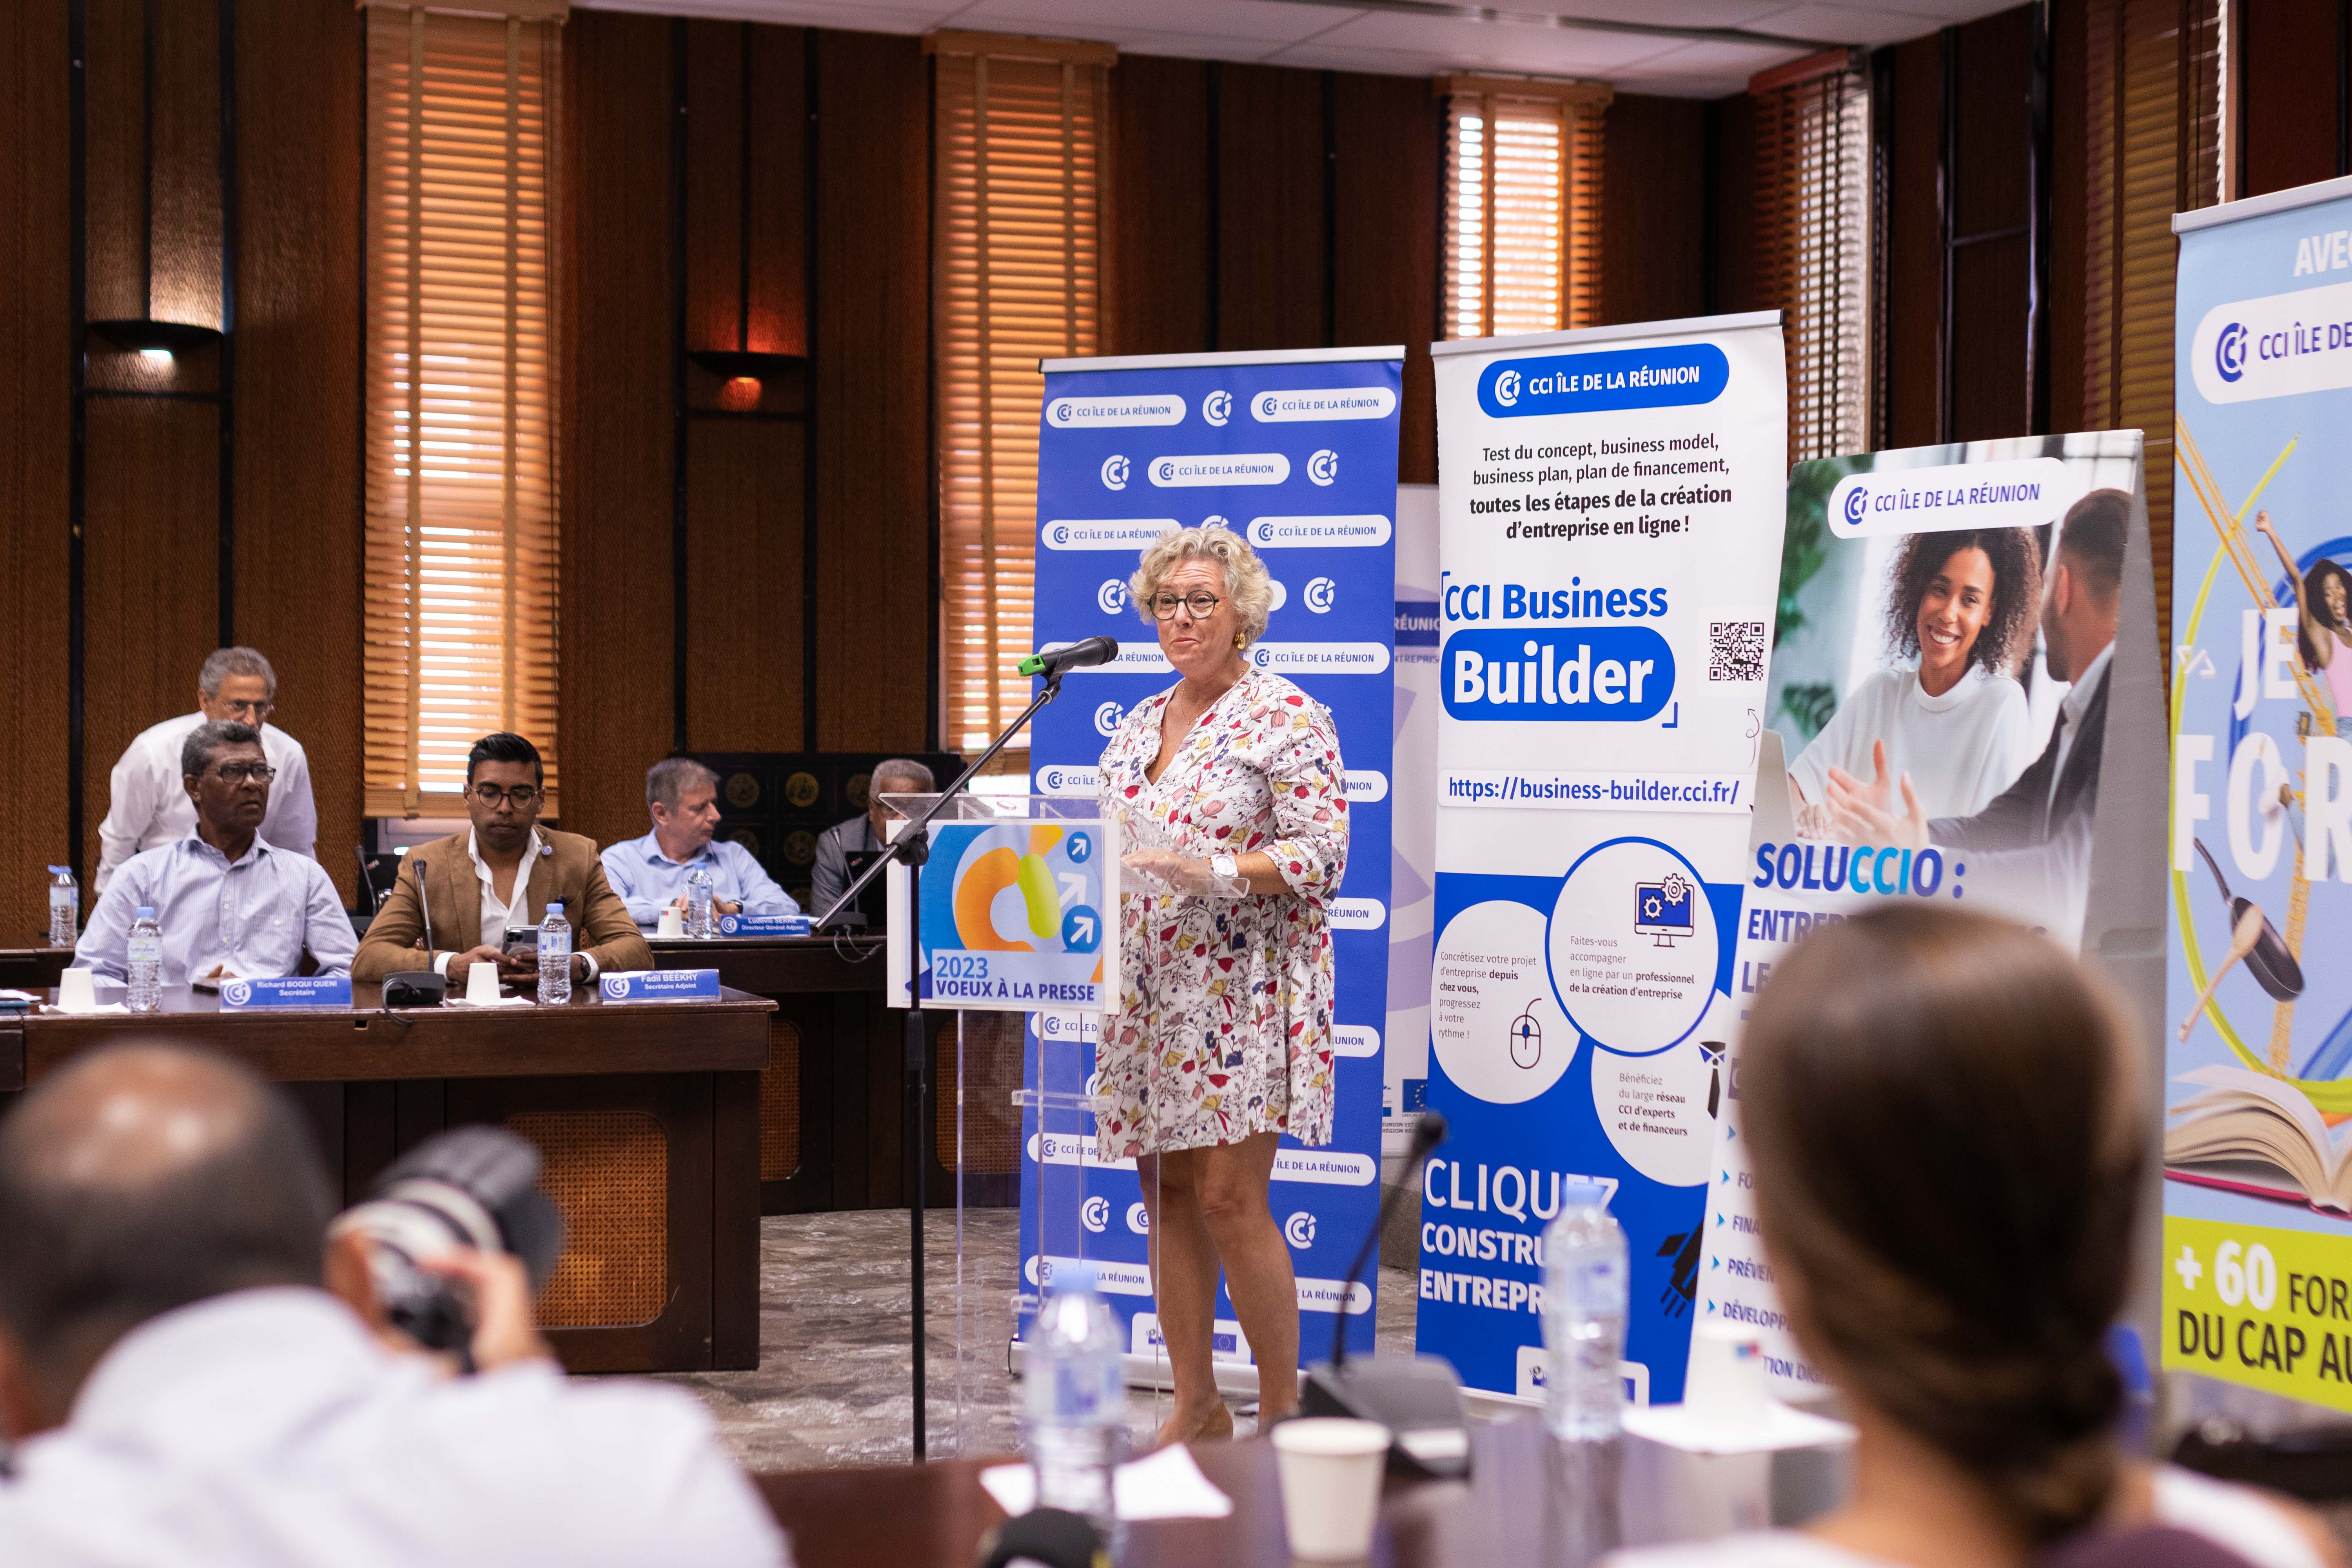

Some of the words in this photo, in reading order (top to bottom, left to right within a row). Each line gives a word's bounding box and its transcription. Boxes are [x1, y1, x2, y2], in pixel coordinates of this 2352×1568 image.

[2294, 230, 2352, 276] AVE
[2259, 332, 2288, 361] CCI
[2294, 321, 2321, 355] ÎLE
[2329, 321, 2352, 350] DE
[1529, 377, 1553, 395] CCI
[1556, 372, 1579, 393] ÎLE
[1583, 374, 1602, 391] DE
[1607, 372, 1626, 389] LA
[1630, 366, 1699, 388] RÉUNION
[1077, 408, 1090, 417] CCI
[1093, 406, 1105, 416] ÎLE
[1107, 408, 1118, 416] DE
[1120, 407, 1131, 416] LA
[1132, 405, 1171, 415] RÉUNION
[1282, 402, 1296, 410] CCI
[1298, 399, 1311, 410] ÎLE
[1314, 401, 1325, 409] DE
[1328, 400, 1338, 409] LA
[1340, 397, 1379, 408] RÉUNION
[1483, 447, 1510, 461] Test
[1514, 445, 1532, 460] du
[1537, 442, 1596, 460] concept,
[1601, 437, 1665, 455] business
[1670, 433, 1719, 451] model,
[1179, 467, 1192, 475] CCI
[1194, 465, 1207, 475] ÎLE
[1209, 466, 1220, 475] DE
[1222, 466, 1232, 474] LA
[1235, 463, 1274, 474] RÉUNION
[1474, 467, 1534, 485] business
[1538, 466, 1572, 486] plan,
[1576, 464, 1607, 483] plan
[1611, 462, 1629, 478] de
[1633, 458, 1729, 476] financement,
[1470, 497, 1521, 514] toutes
[1526, 494, 1550, 512] les
[1554, 491, 1610, 514] étapes
[1615, 490, 1636, 508] de
[1641, 489, 1656, 506] la
[1661, 483, 1731, 506] création
[1875, 494, 1896, 512] CCI
[1900, 488, 1921, 510] ÎLE
[1924, 490, 1943, 508] DE
[1947, 489, 1964, 506] LA
[1969, 483, 2040, 505] RÉUNION
[1074, 531, 1087, 539] CCI
[1089, 529, 1102, 539] ÎLE
[1104, 531, 1114, 539] DE
[1129, 528, 1162, 539] RÉUNIO
[1279, 528, 1292, 536] CCI
[1295, 525, 1308, 536] ÎLE
[1310, 528, 1321, 536] DE
[1338, 524, 1376, 535] RÉUNION
[1506, 517, 1609, 541] d’entreprise
[1613, 521, 1634, 535] en
[1639, 514, 1681, 538] ligne
[1445, 584, 1490, 621] CCI
[1503, 576, 1668, 620] Business
[1275, 654, 1289, 662] CCI
[1291, 652, 1304, 662] ÎLE
[1334, 652, 1374, 662] RÉUNION
[2232, 606, 2298, 720] JE
[1454, 640, 1654, 704] Builder
[1067, 777, 1080, 785] CCI
[1082, 775, 1095, 785] ÎLE
[1449, 776, 1739, 805] https://business-builder.cci.fr/
[1753, 842, 1943, 897] SOLUCCIO
[1328, 906, 1369, 918] RÉUNION
[1571, 935, 1618, 947] Faites-vous
[1441, 951, 1484, 963] Concrétisez
[1486, 955, 1509, 964] votre
[1512, 955, 1536, 967] projet
[1570, 953, 1626, 965] accompagner
[936, 956, 988, 979] 2023
[1440, 966, 1486, 979] d’entreprise
[1489, 969, 1518, 982] depuis
[662, 974, 698, 982] BEEKHY
[1583, 968, 1603, 980] ligne
[1606, 971, 1619, 980] par
[1636, 971, 1695, 984] professionnel
[936, 980, 993, 997] VOEUX
[997, 981, 1009, 998] À
[1014, 983, 1034, 998] LA
[1039, 984, 1094, 1001] PRESSE
[1440, 982, 1455, 992] chez
[1457, 985, 1479, 995] vous,
[1570, 983, 1580, 992] de
[1582, 984, 1590, 993] la
[1592, 985, 1628, 995] création
[1630, 986, 1682, 1000] d’entreprise
[1439, 999, 1481, 1009] progressez
[1439, 1011, 1443, 1021] à
[1445, 1014, 1464, 1023] votre
[1065, 1022, 1078, 1031] CCI
[1439, 1028, 1465, 1039] rythme
[1619, 1072, 1662, 1085] Bénéficiez
[1619, 1089, 1630, 1098] du
[1633, 1090, 1654, 1102] large
[1656, 1091, 1685, 1103] réseau
[1619, 1104, 1632, 1114] CCI
[1634, 1105, 1675, 1119] d’experts
[1618, 1122, 1627, 1130] et
[1629, 1121, 1641, 1131] de
[1642, 1122, 1688, 1136] financeurs
[1277, 1158, 1289, 1169] ÎLE
[1292, 1161, 1303, 1171] DE
[1306, 1162, 1317, 1171] LA
[1319, 1161, 1360, 1174] RÉUNION
[1108, 1272, 1144, 1284] RÉUNION
[2175, 1245, 2203, 1291] +
[2214, 1240, 2278, 1312] 60
[1302, 1290, 1312, 1299] LA
[1315, 1289, 1355, 1302] RÉUNION
[1420, 1268, 1546, 1315] ENTREPR
[2179, 1309, 2224, 1361] DU
[2237, 1319, 2306, 1374] CAP
